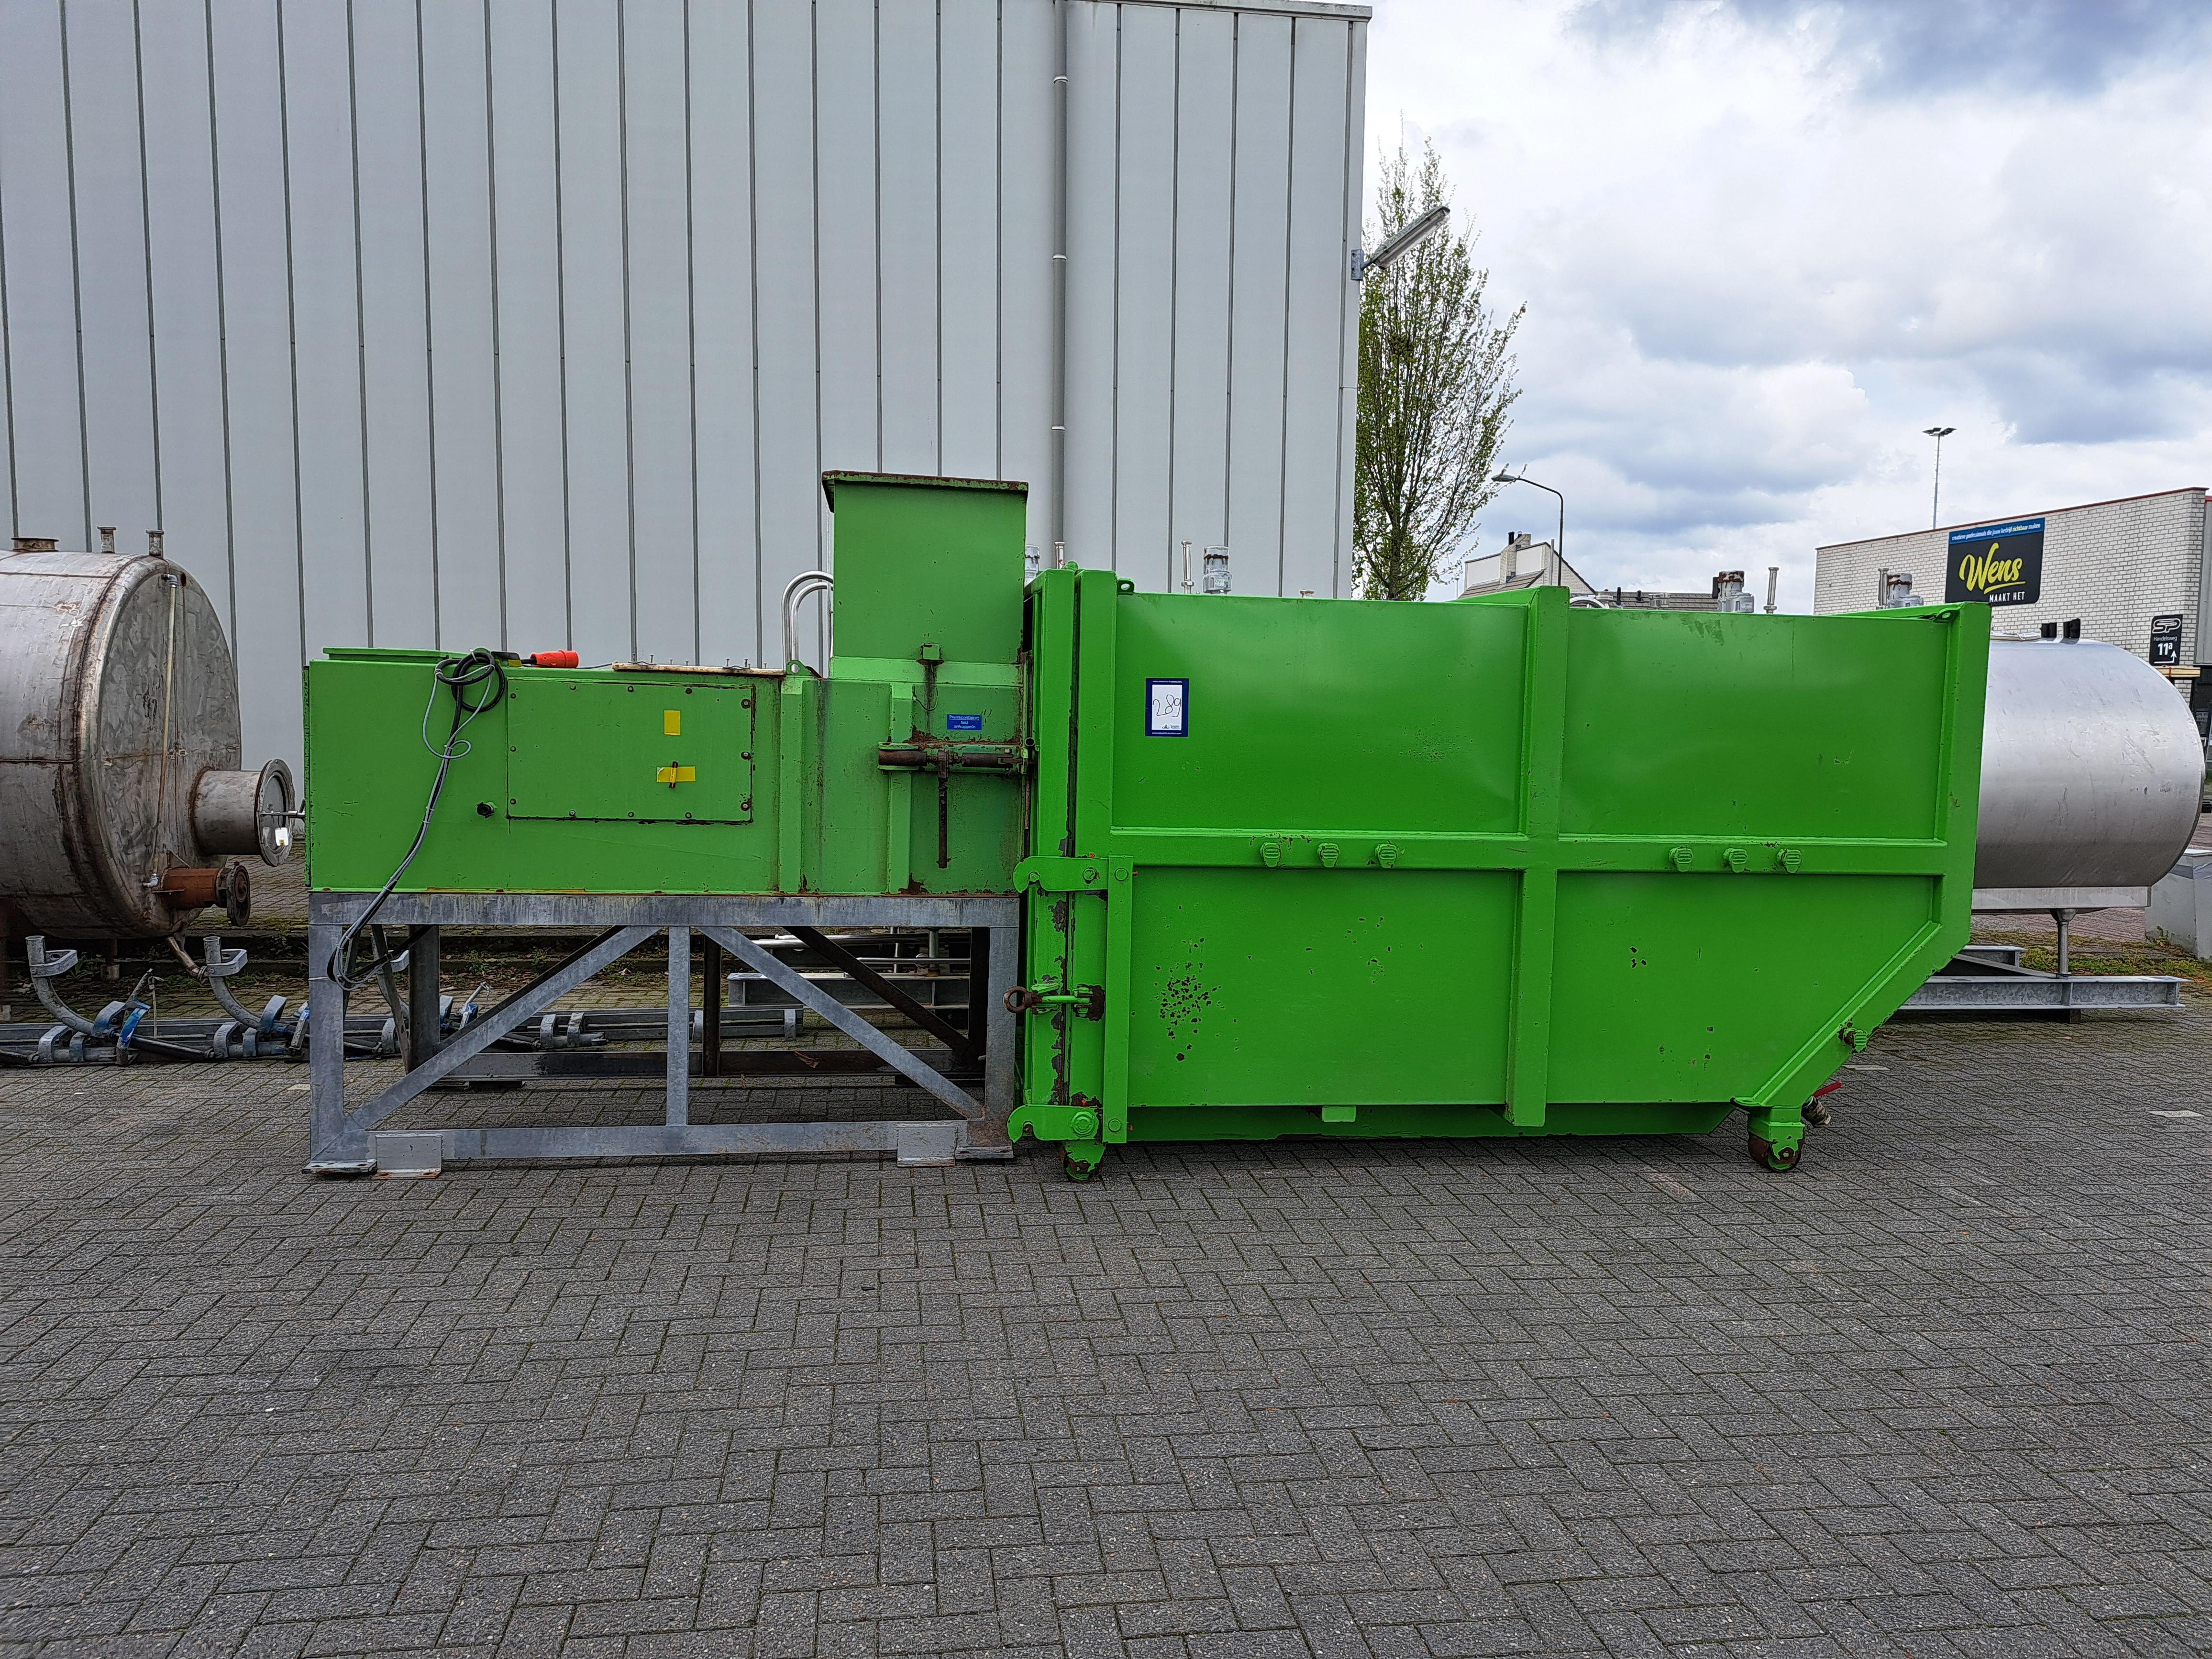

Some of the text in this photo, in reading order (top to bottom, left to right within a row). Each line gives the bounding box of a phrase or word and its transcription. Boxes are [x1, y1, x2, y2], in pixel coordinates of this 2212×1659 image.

[1959, 542, 2023, 591] Wens
[1989, 591, 2025, 603] MAAKT HET
[2152, 618, 2181, 633] SP
[1152, 694, 1181, 718] 289
